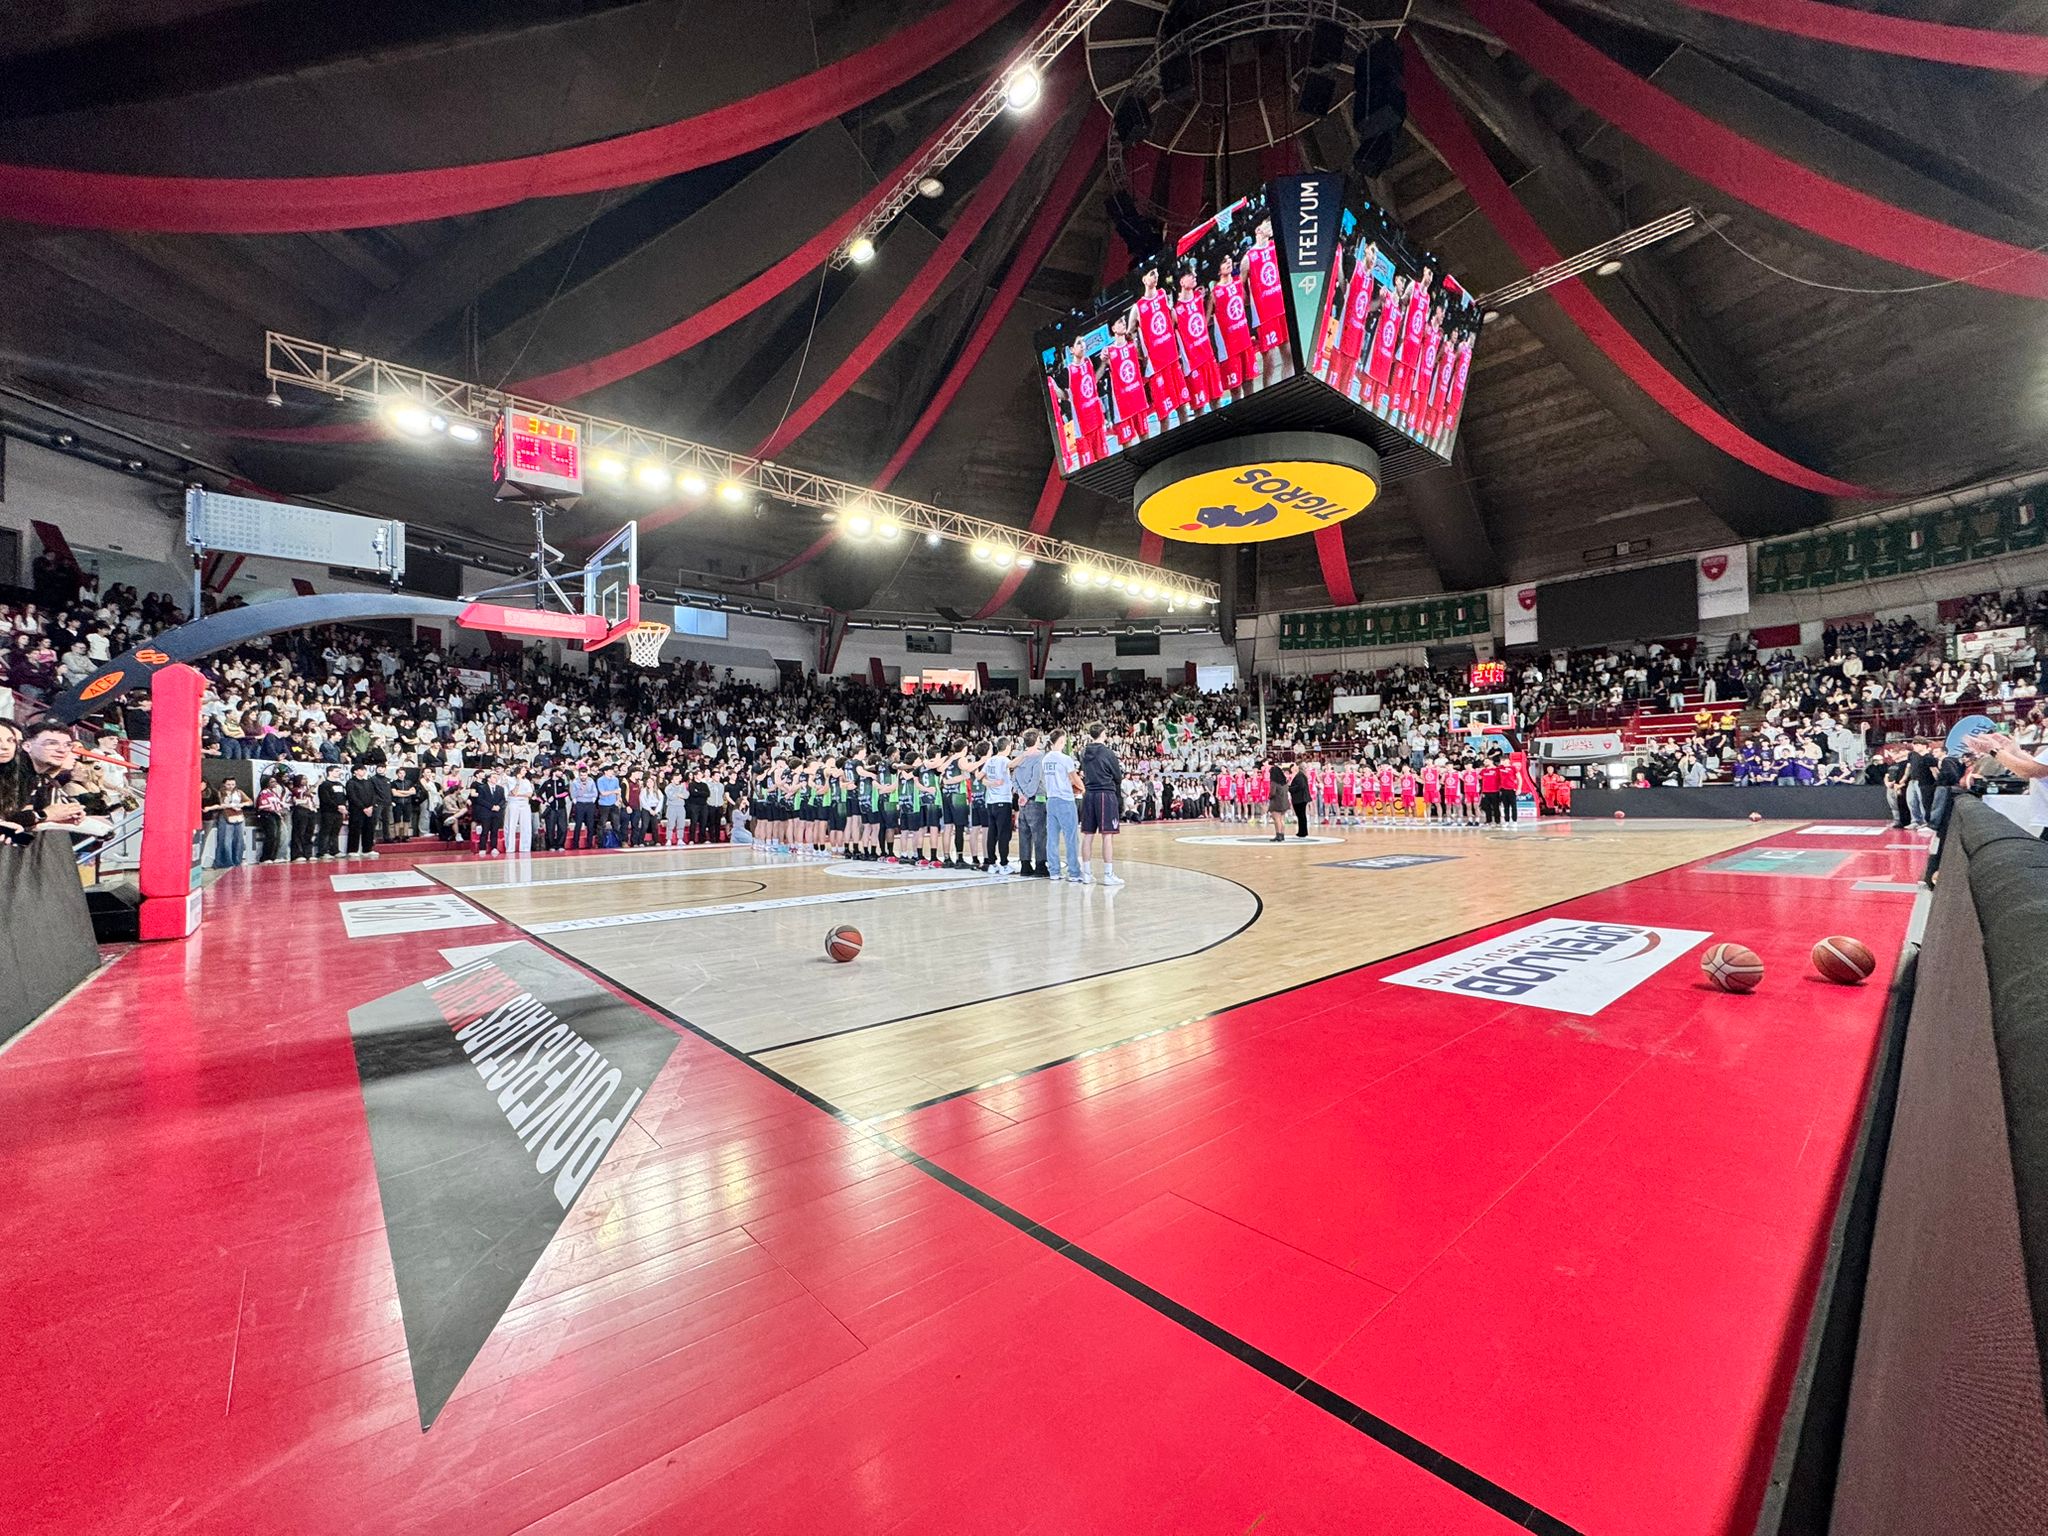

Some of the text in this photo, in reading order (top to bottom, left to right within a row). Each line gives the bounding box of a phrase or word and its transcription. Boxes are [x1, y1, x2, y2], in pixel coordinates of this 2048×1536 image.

[1299, 182, 1319, 266] ITELYUM
[1227, 285, 1238, 297] 13
[1150, 301, 1161, 312] 15
[1186, 303, 1198, 314] 14
[1266, 331, 1278, 345] 12
[1119, 348, 1130, 359] 16
[1227, 373, 1238, 386] 13
[528, 416, 576, 442] 3:17
[1122, 426, 1132, 438] 16
[515, 434, 574, 478] 24
[1233, 469, 1348, 520] TIGROS
[1474, 670, 1494, 683] 24
[89, 676, 117, 696] ACE
[901, 780, 907, 794] 7
[922, 774, 929, 787] 6
[1417, 934, 1550, 986] CONSULTING
[1452, 925, 1642, 996] OPENJOB
